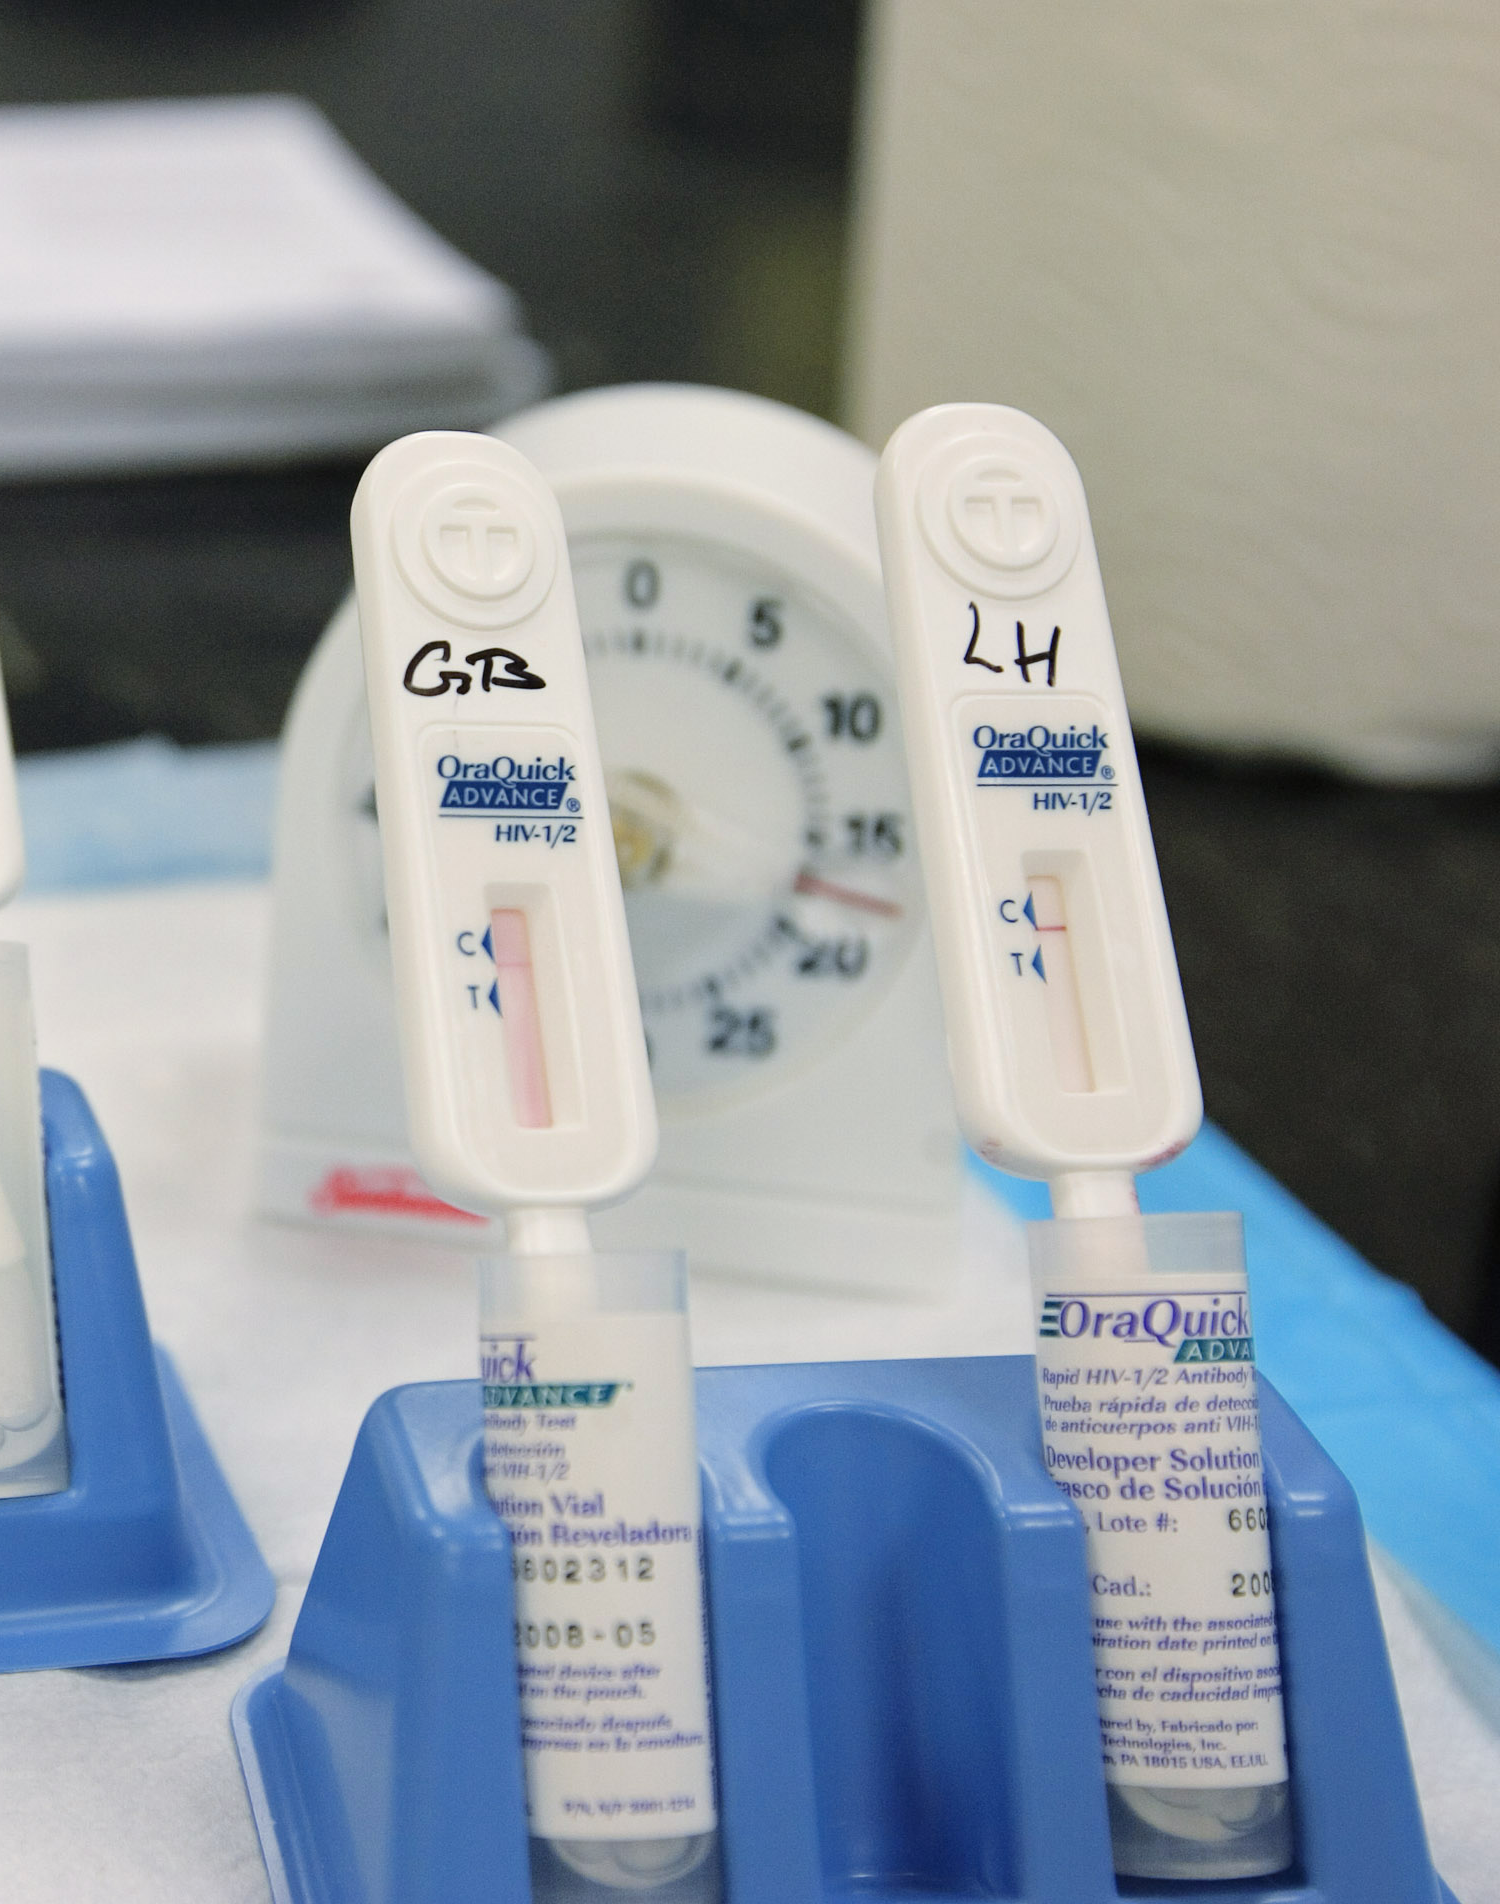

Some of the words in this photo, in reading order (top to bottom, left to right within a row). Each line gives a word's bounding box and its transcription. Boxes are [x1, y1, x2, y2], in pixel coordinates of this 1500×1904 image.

[624, 559, 660, 609] 0
[747, 599, 782, 648] 5
[964, 601, 1061, 687] LH
[403, 640, 546, 696] GB
[821, 693, 882, 742] 10
[973, 724, 1109, 756] OraQuick
[437, 754, 576, 787] OraQuick
[1033, 792, 1112, 816] HIV-1/2
[495, 824, 577, 849] HIV-1/2
[845, 815, 901, 857] 15
[1000, 899, 1018, 923] C
[457, 931, 474, 955] C
[796, 939, 867, 977] 20
[1011, 952, 1024, 977] T
[467, 985, 479, 1010] T
[707, 1009, 777, 1059] 25
[1059, 1297, 1250, 1348] OraQuick
[1042, 1367, 1079, 1389] Rapid
[1086, 1368, 1169, 1391] HIV-1/2
[1175, 1367, 1248, 1387] Antibody
[1043, 1394, 1092, 1412] Prueba
[1099, 1395, 1166, 1418] rápida
[1175, 1396, 1199, 1412] de
[1045, 1417, 1057, 1432] de
[1061, 1416, 1176, 1440] anticuerpos
[1184, 1416, 1220, 1434] anti
[1046, 1446, 1160, 1479] Developer
[1170, 1446, 1260, 1471] Solution
[1120, 1477, 1154, 1500] de
[1165, 1475, 1261, 1500] Solución
[549, 1493, 604, 1517] Vial
[1097, 1511, 1148, 1533] Lote
[513, 1557, 655, 1585] 602312
[1095, 1617, 1123, 1631] use
[1128, 1615, 1167, 1631] with
[1173, 1616, 1202, 1632] the
[1207, 1610, 1272, 1631] associated
[515, 1621, 656, 1649] 008-05
[1158, 1634, 1198, 1651] date
[1203, 1631, 1257, 1656] printed
[1105, 1669, 1135, 1682] con
[1141, 1667, 1158, 1682] el
[1163, 1665, 1252, 1689] dispositivo
[1132, 1686, 1155, 1701] de
[1160, 1683, 1249, 1702] caducidad
[1161, 1720, 1232, 1734] Fabricado
[1201, 1738, 1226, 1750] Inc.
[1121, 1754, 1140, 1766] PA
